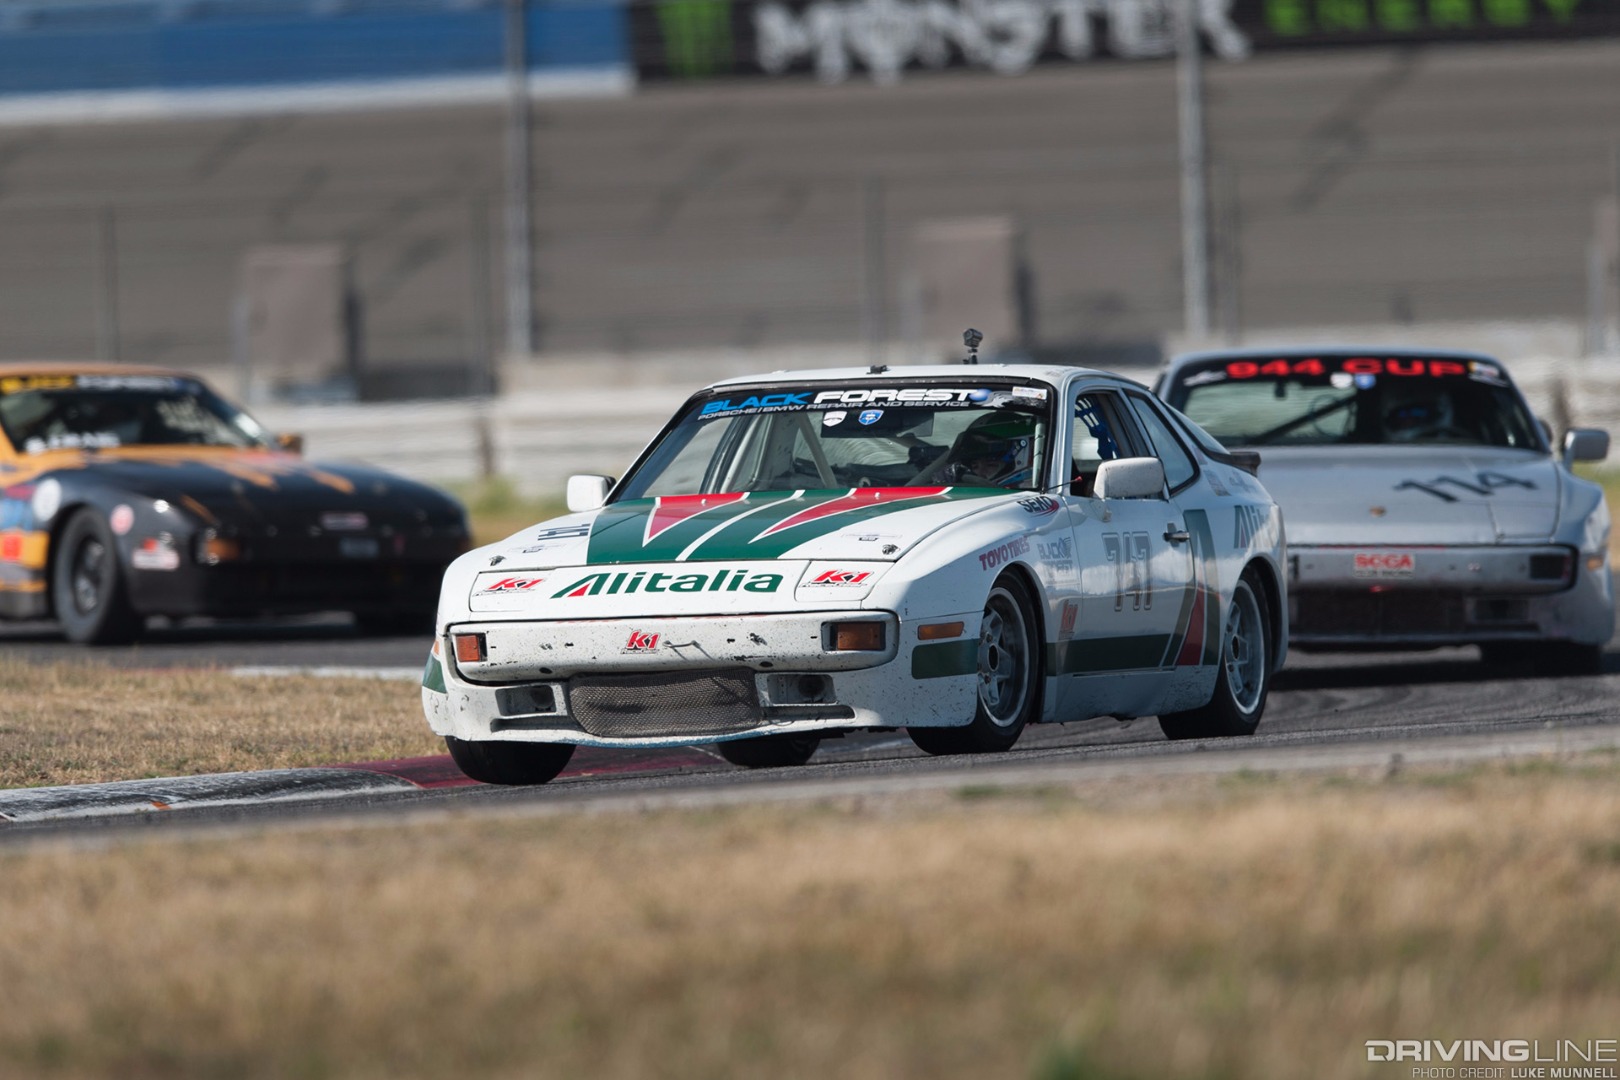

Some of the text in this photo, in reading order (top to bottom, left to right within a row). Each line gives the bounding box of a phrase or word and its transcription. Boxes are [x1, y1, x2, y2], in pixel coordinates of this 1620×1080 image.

[1226, 359, 1324, 379] 944
[1343, 358, 1466, 378] CUP
[697, 404, 805, 421] PORSCHE/BMW
[806, 402, 863, 410] REPAIR
[701, 389, 978, 415] BLACK FOREST
[979, 536, 1031, 571] TOYO TIRES
[550, 569, 783, 599] Alitalia
[812, 569, 872, 583] K1
[626, 630, 660, 649] K1
